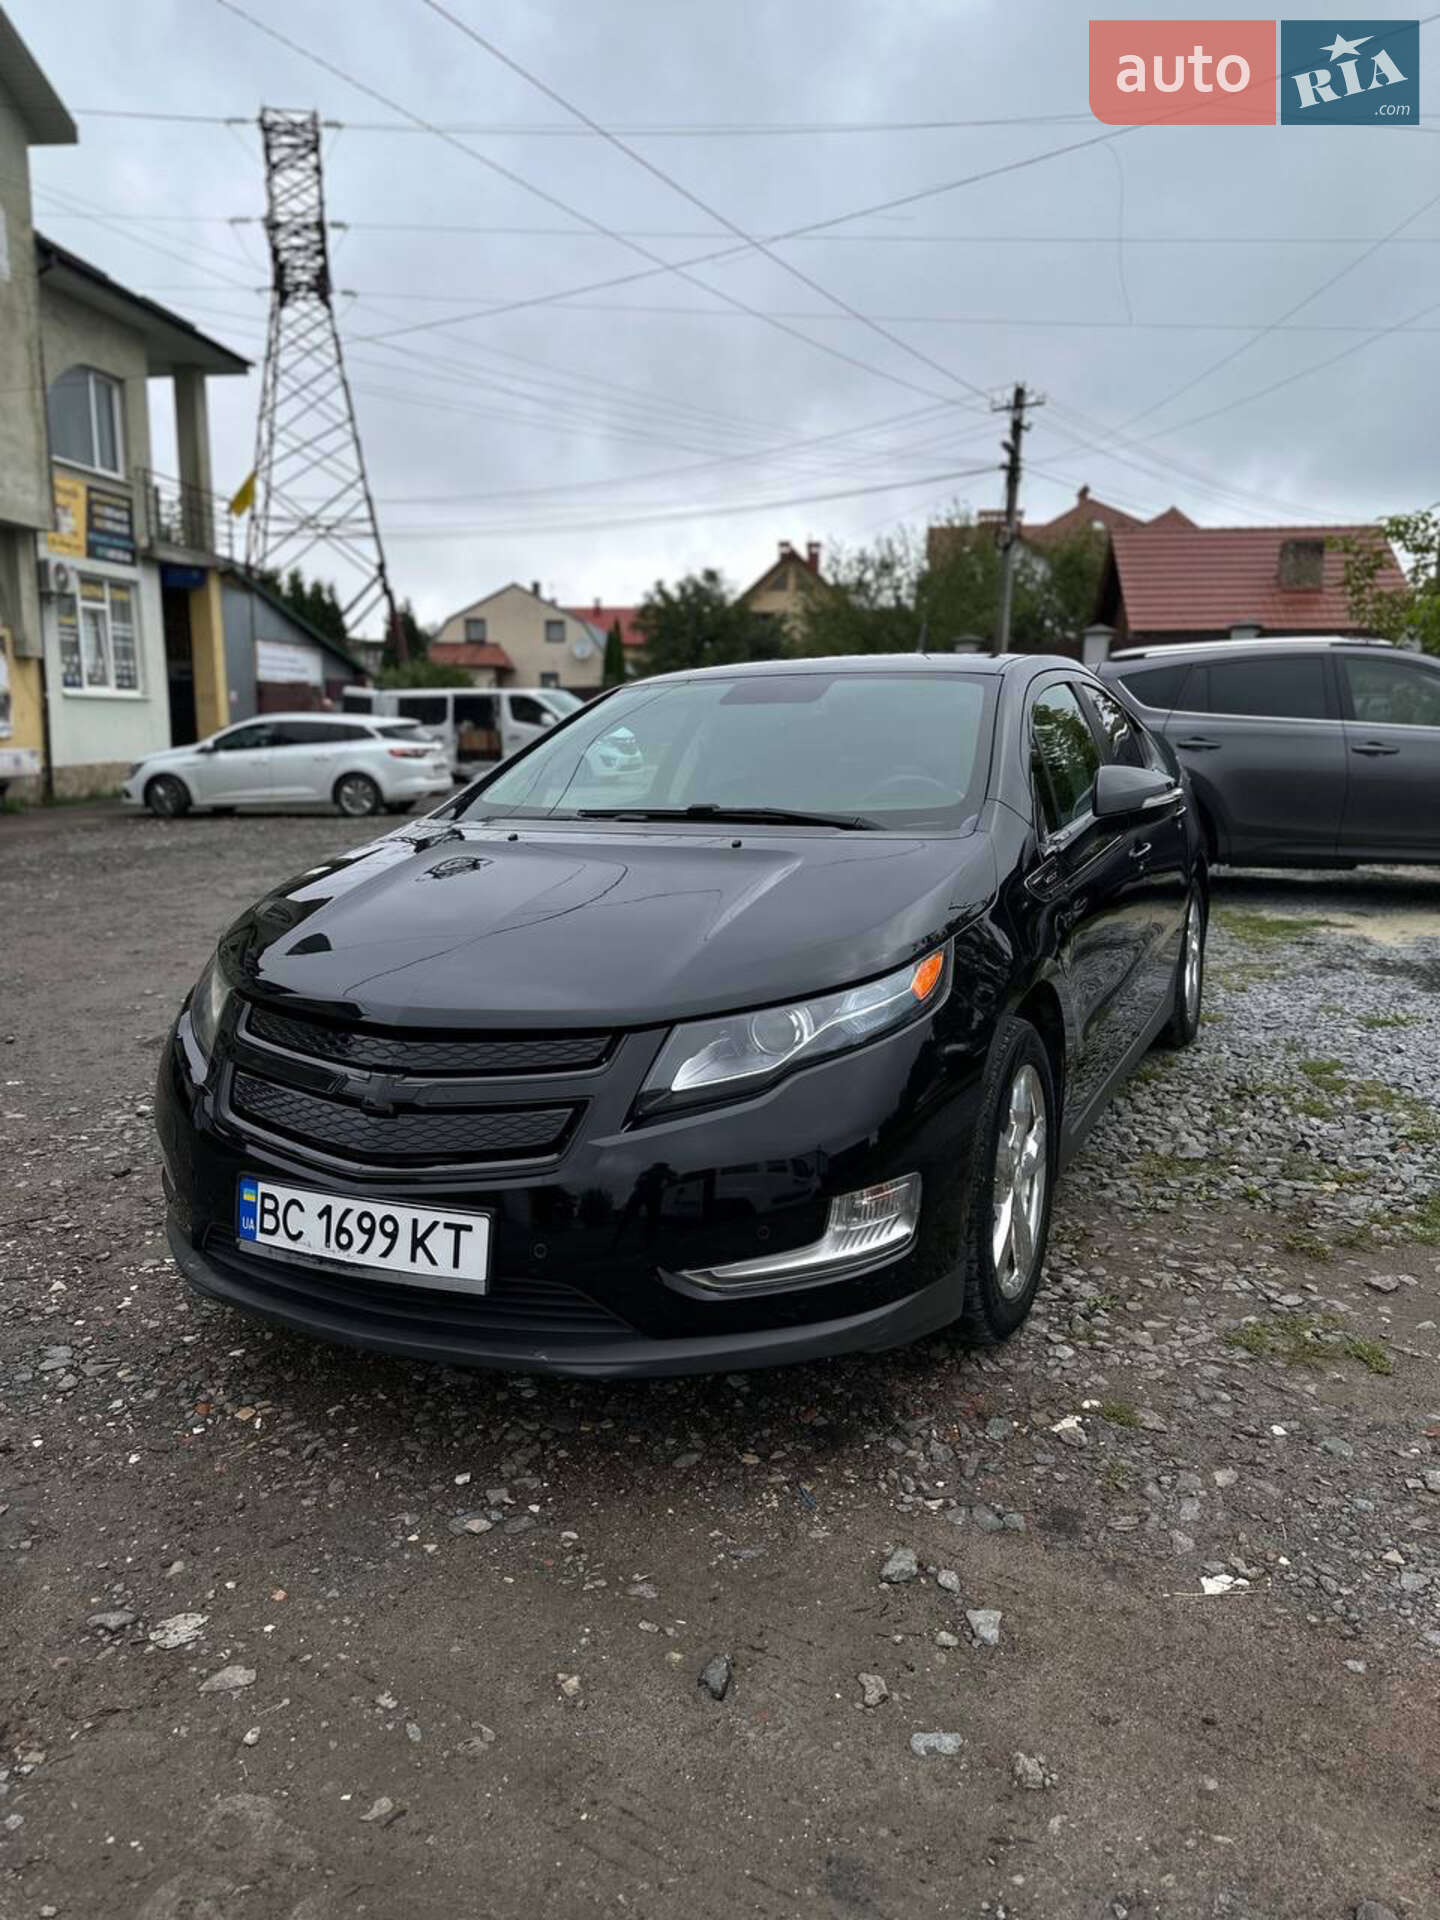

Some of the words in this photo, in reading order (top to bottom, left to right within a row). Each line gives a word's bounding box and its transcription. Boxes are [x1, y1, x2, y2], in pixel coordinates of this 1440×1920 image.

[242, 1216, 255, 1230] UA
[259, 1192, 305, 1241] BC
[317, 1204, 400, 1258] 1699
[409, 1217, 473, 1269] KT
